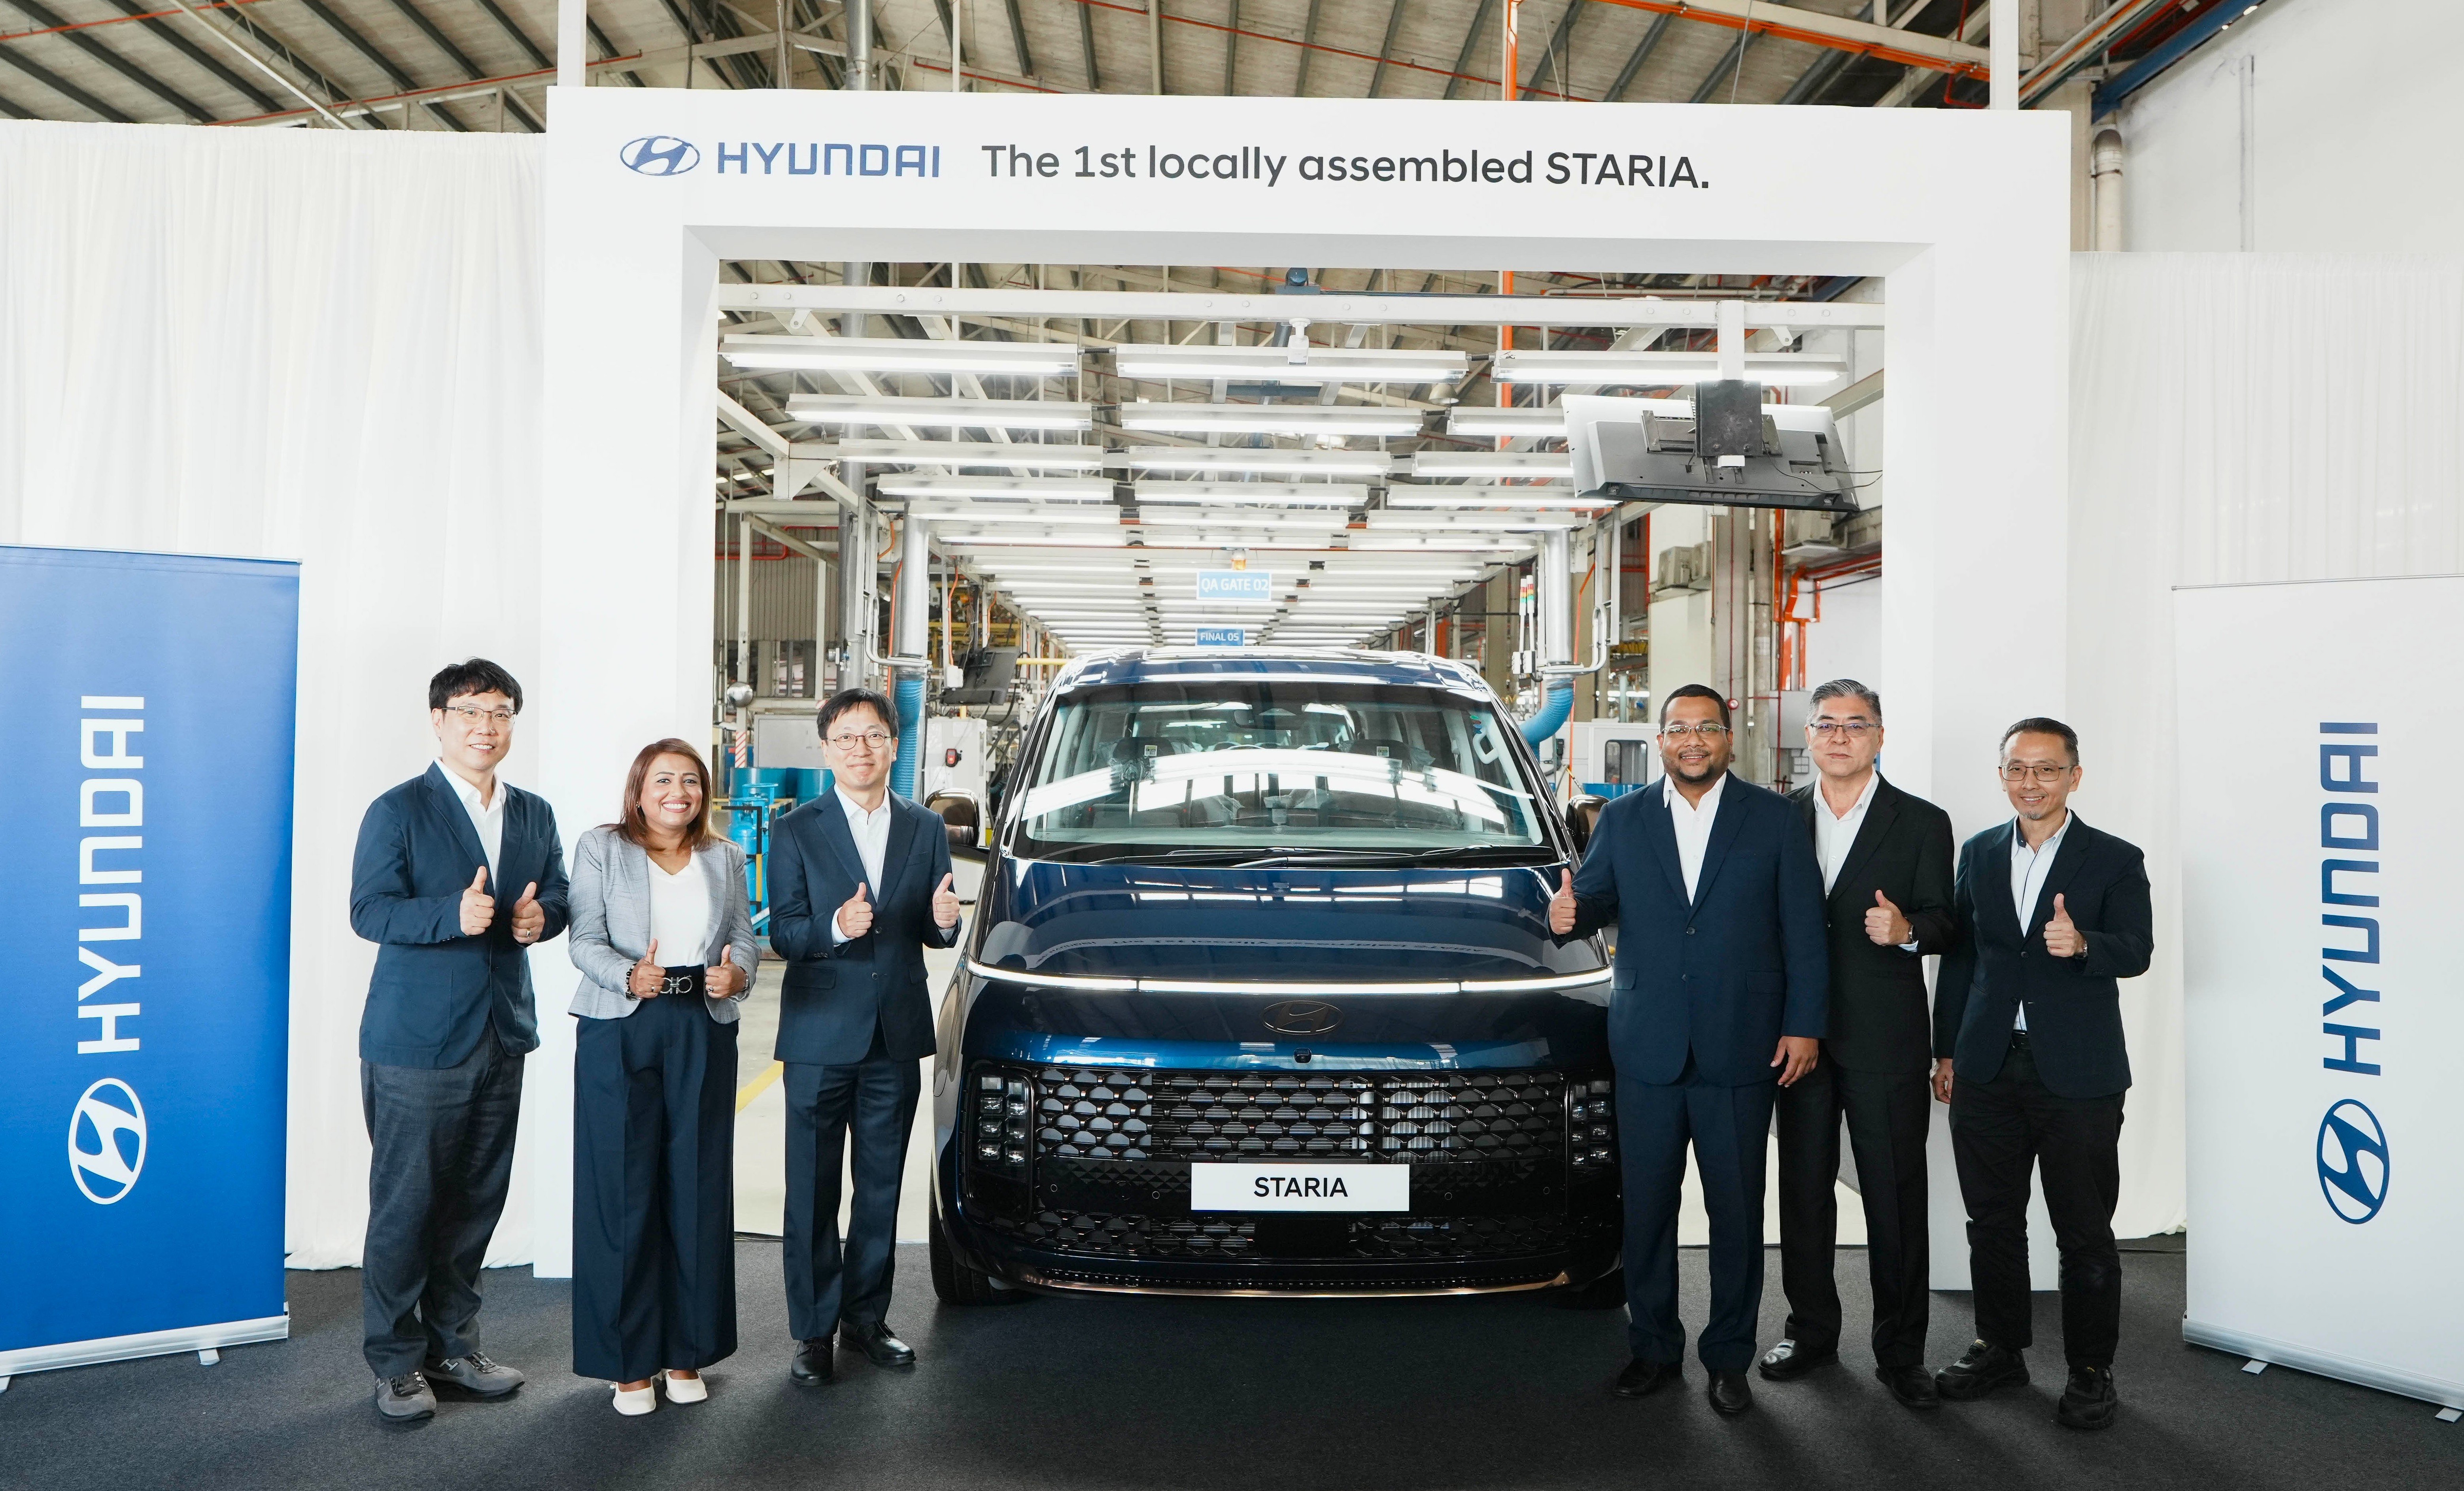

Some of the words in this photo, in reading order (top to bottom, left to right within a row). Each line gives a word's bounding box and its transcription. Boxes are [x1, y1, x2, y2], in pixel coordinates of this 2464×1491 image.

[718, 142, 939, 177] HYUNDAI
[981, 144, 1059, 177] The
[1074, 145, 1136, 178] 1st
[1149, 145, 1287, 187] locally
[1299, 149, 1532, 183] assembled
[1545, 152, 1709, 189] STARIA.
[1201, 578, 1219, 593] QA
[1221, 578, 1251, 591] GATE
[1253, 578, 1268, 591] 02
[1200, 632, 1226, 641] FINAL
[1227, 632, 1240, 641] 05
[77, 695, 145, 1054] HYUNDAI
[2320, 722, 2381, 1076] HYUNDAI
[1254, 1177, 1348, 1197] STARIA
